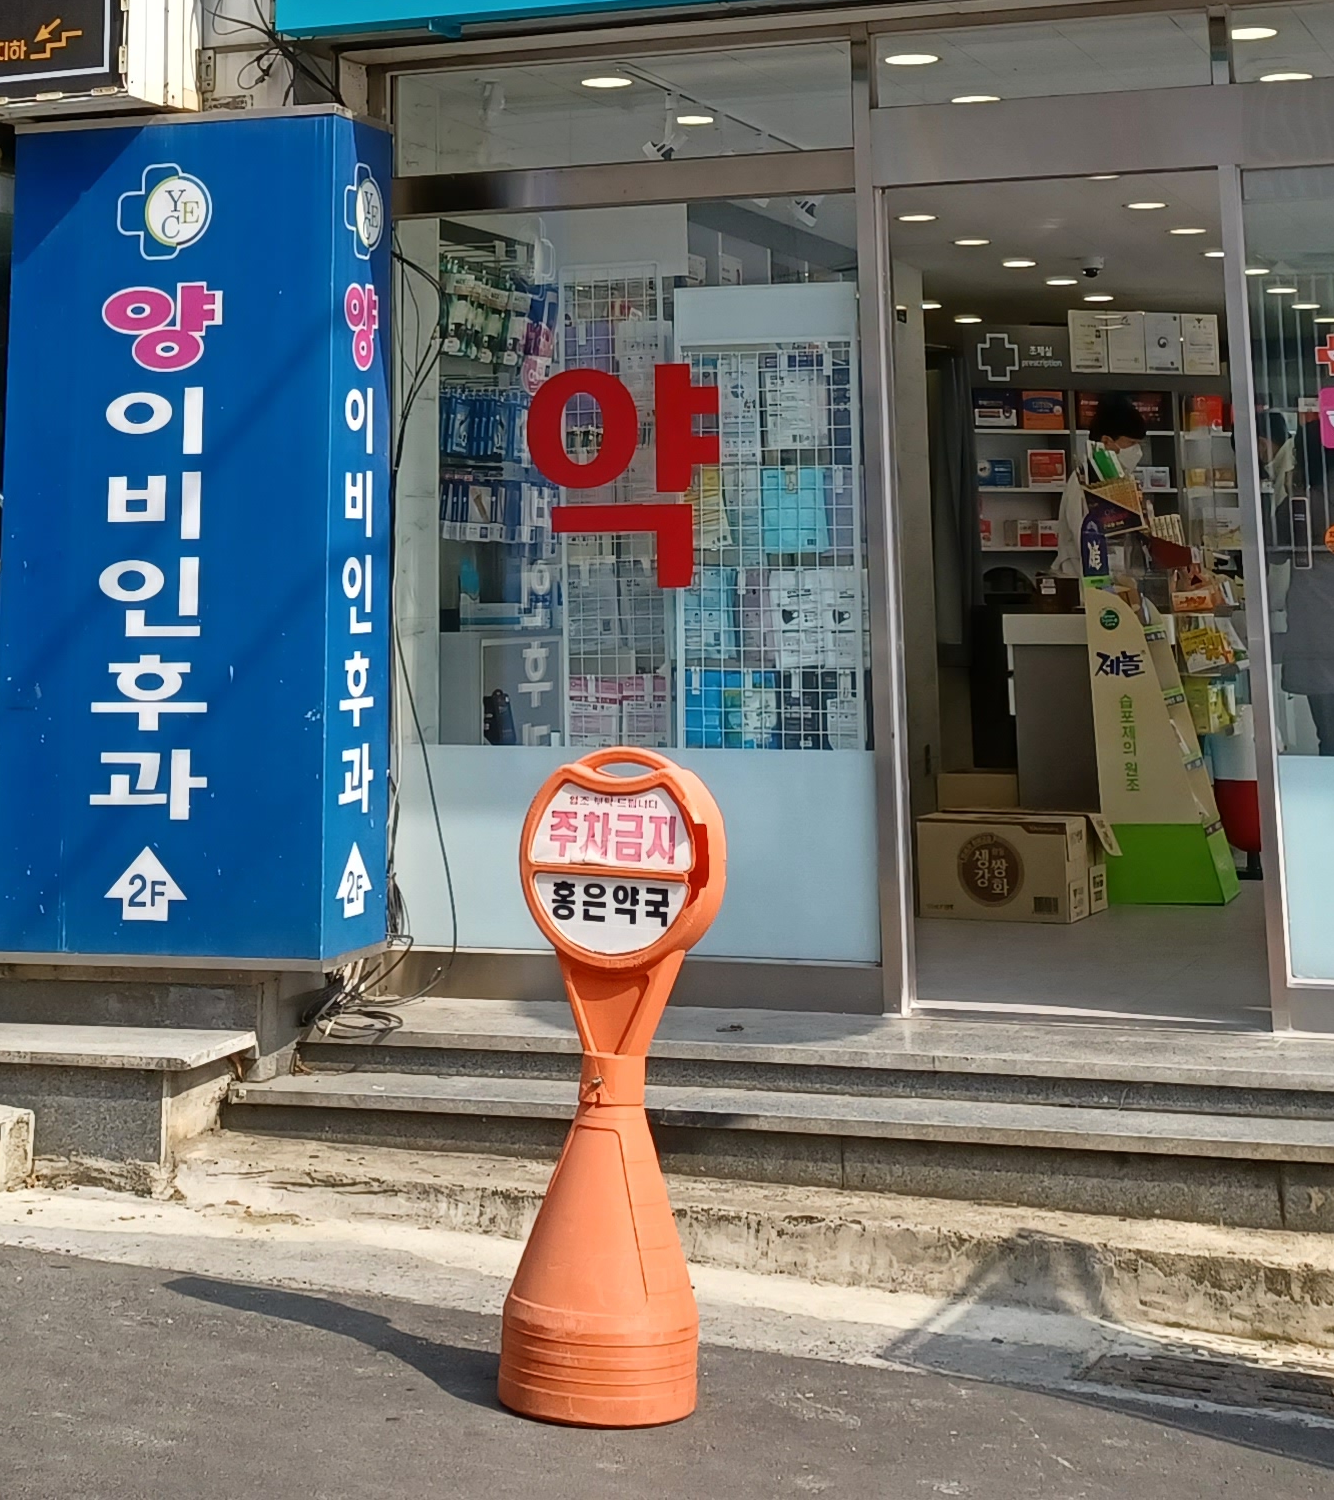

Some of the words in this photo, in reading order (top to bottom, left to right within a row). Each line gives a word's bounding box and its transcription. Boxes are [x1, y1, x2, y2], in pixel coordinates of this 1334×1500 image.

[527, 363, 720, 588] 약
[89, 281, 223, 821] 양이비인후과
[338, 282, 380, 815] 양이비인후과
[1095, 650, 1145, 678] 제놀
[1119, 694, 1138, 757] 습포제의
[1123, 761, 1140, 792] 원조
[549, 810, 678, 865] 주차금지
[128, 873, 167, 909] 2F
[346, 870, 364, 905] 2F
[551, 881, 670, 928] 홍은약국
